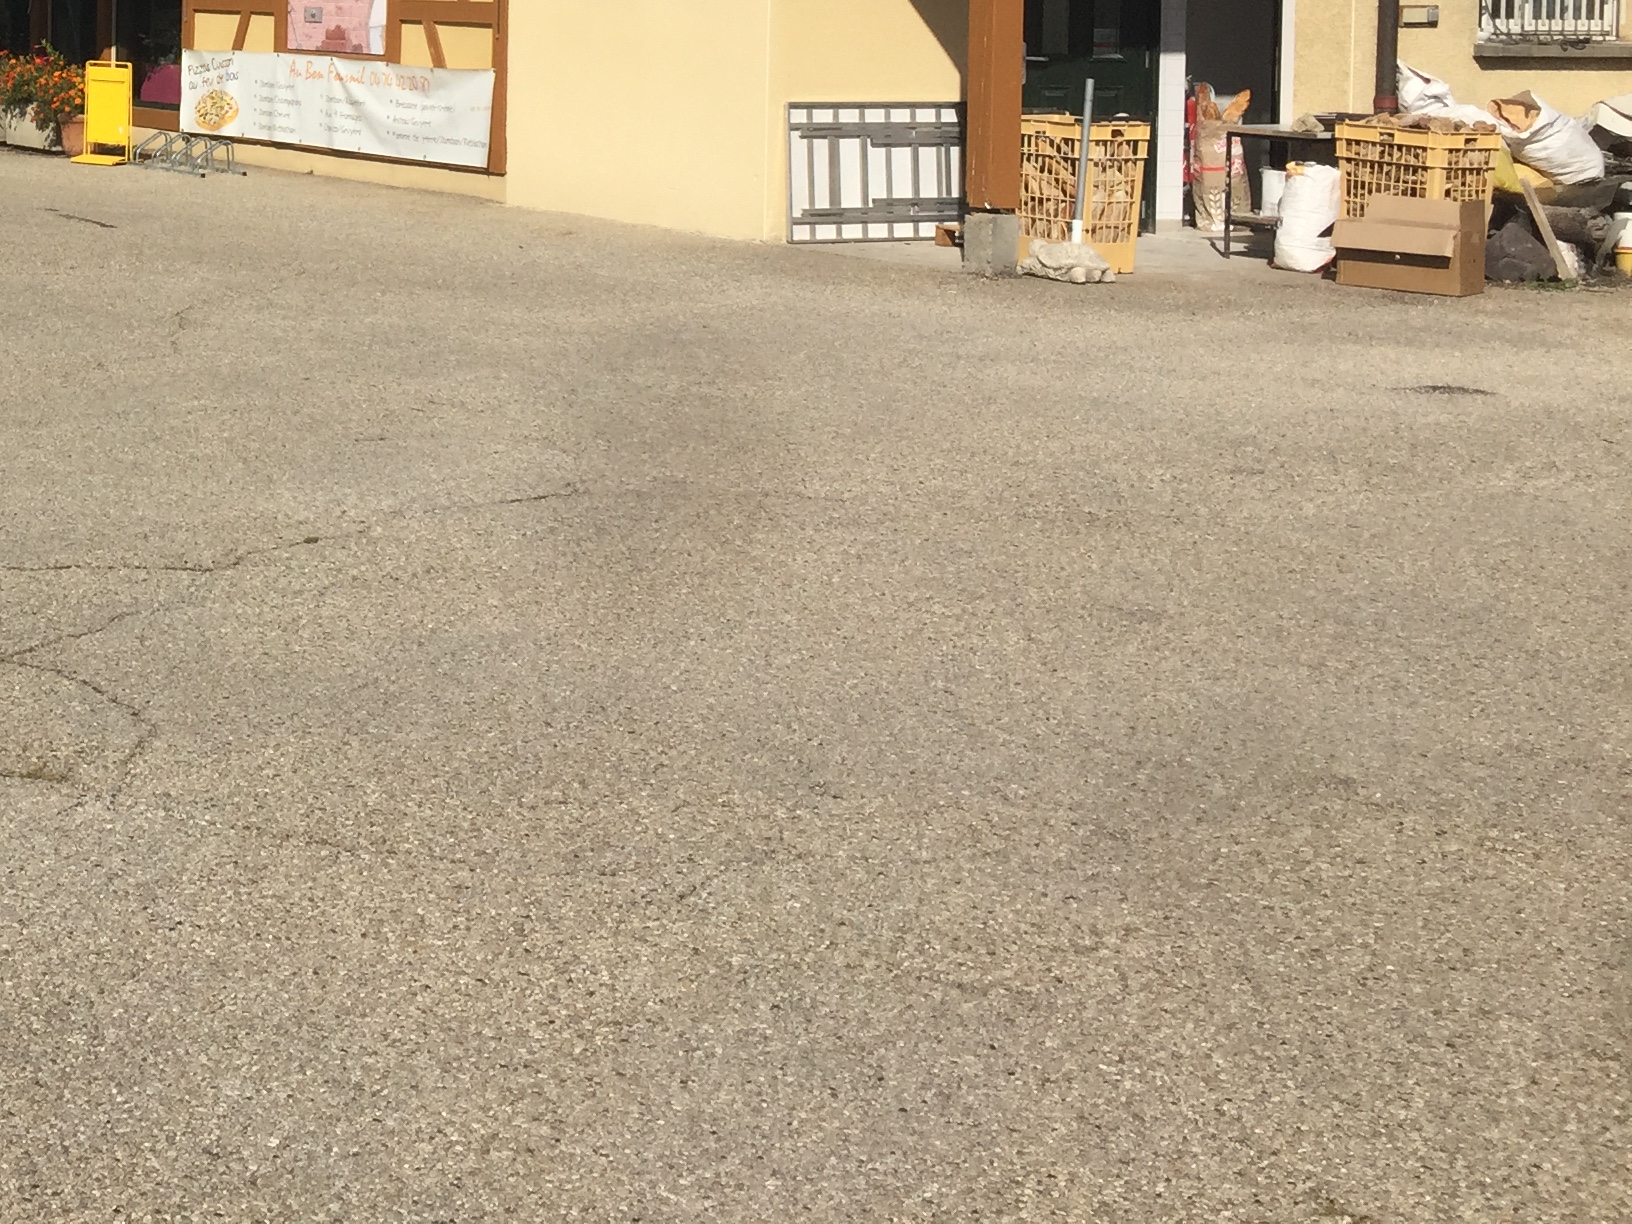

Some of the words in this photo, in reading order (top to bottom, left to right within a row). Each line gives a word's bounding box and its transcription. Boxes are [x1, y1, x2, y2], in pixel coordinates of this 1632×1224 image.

[289, 58, 302, 80] Au
[305, 60, 324, 81] Bon
[327, 59, 365, 85] Fournil
[189, 80, 198, 90] au
[202, 75, 214, 87] feu
